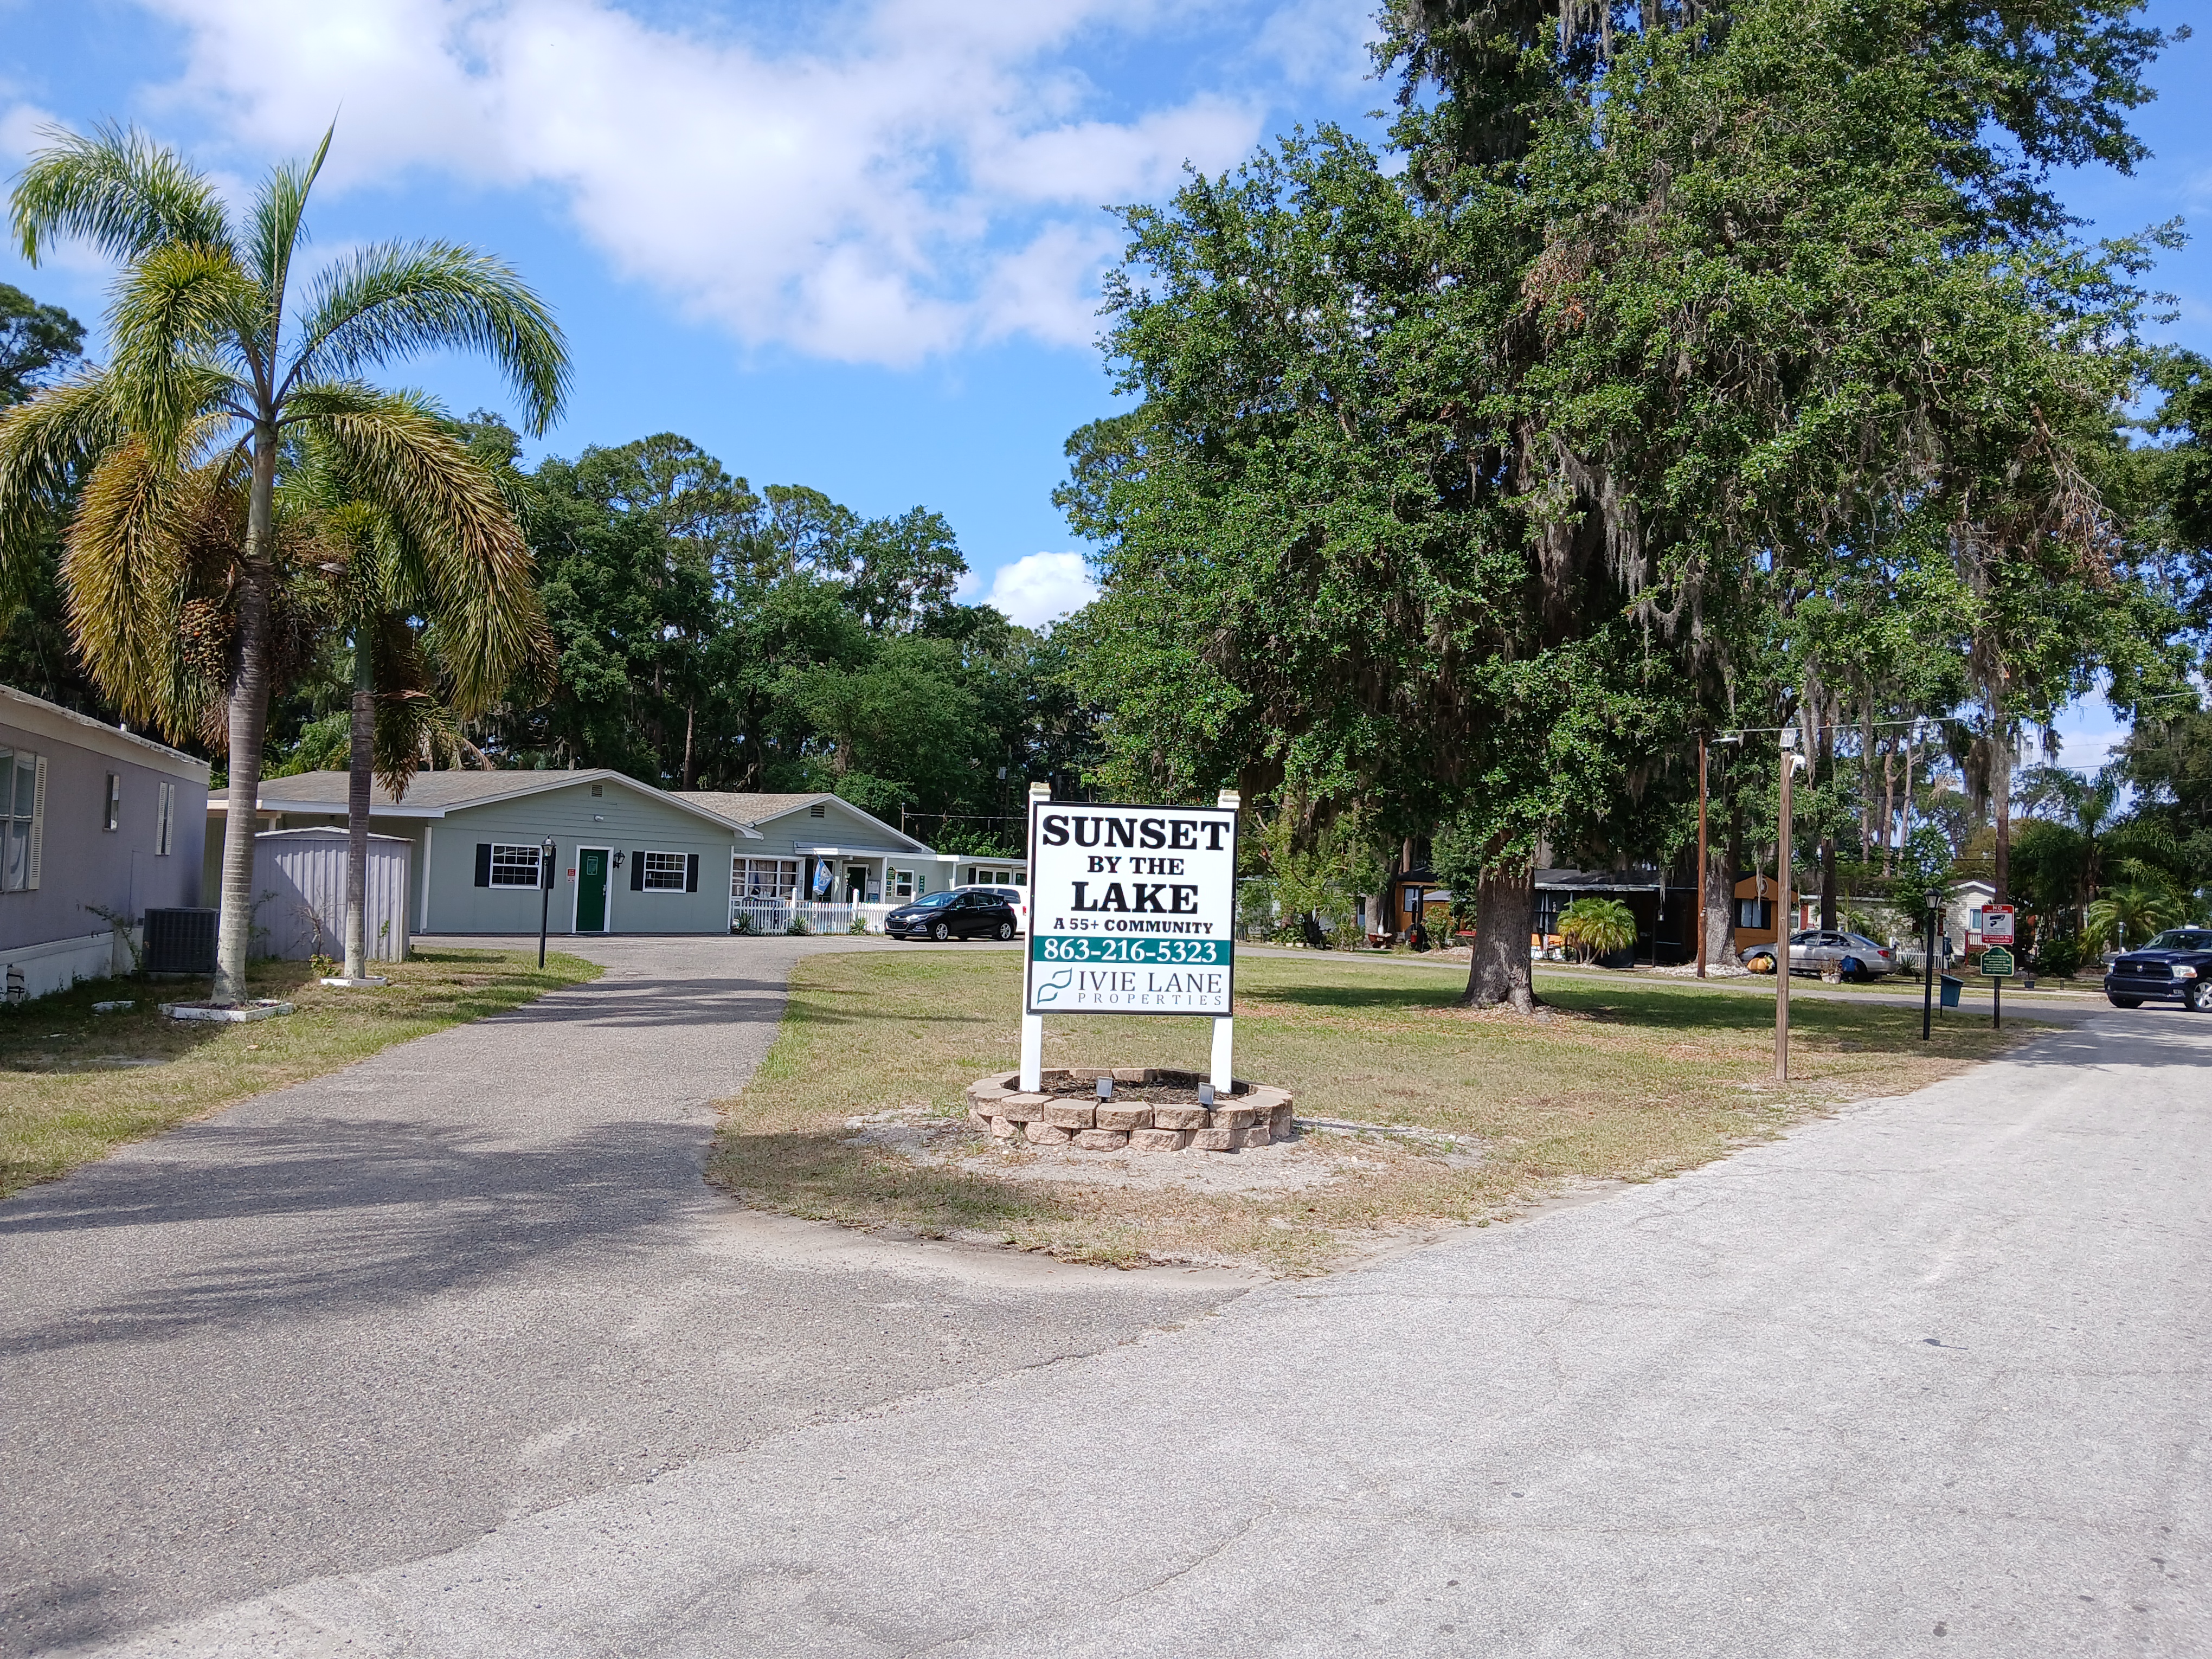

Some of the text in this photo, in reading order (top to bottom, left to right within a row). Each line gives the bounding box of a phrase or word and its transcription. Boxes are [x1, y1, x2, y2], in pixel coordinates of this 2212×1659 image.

[1043, 814, 1230, 851] SUNSET
[1087, 856, 1184, 876] BY THE
[1070, 881, 1198, 915] LAKE
[1053, 917, 1213, 934] A 55+ COMMUNITY
[1044, 938, 1217, 963] 863-216-5323
[1078, 970, 1222, 993] IVIE LANE
[1078, 993, 1221, 1006] PROPERTIES
